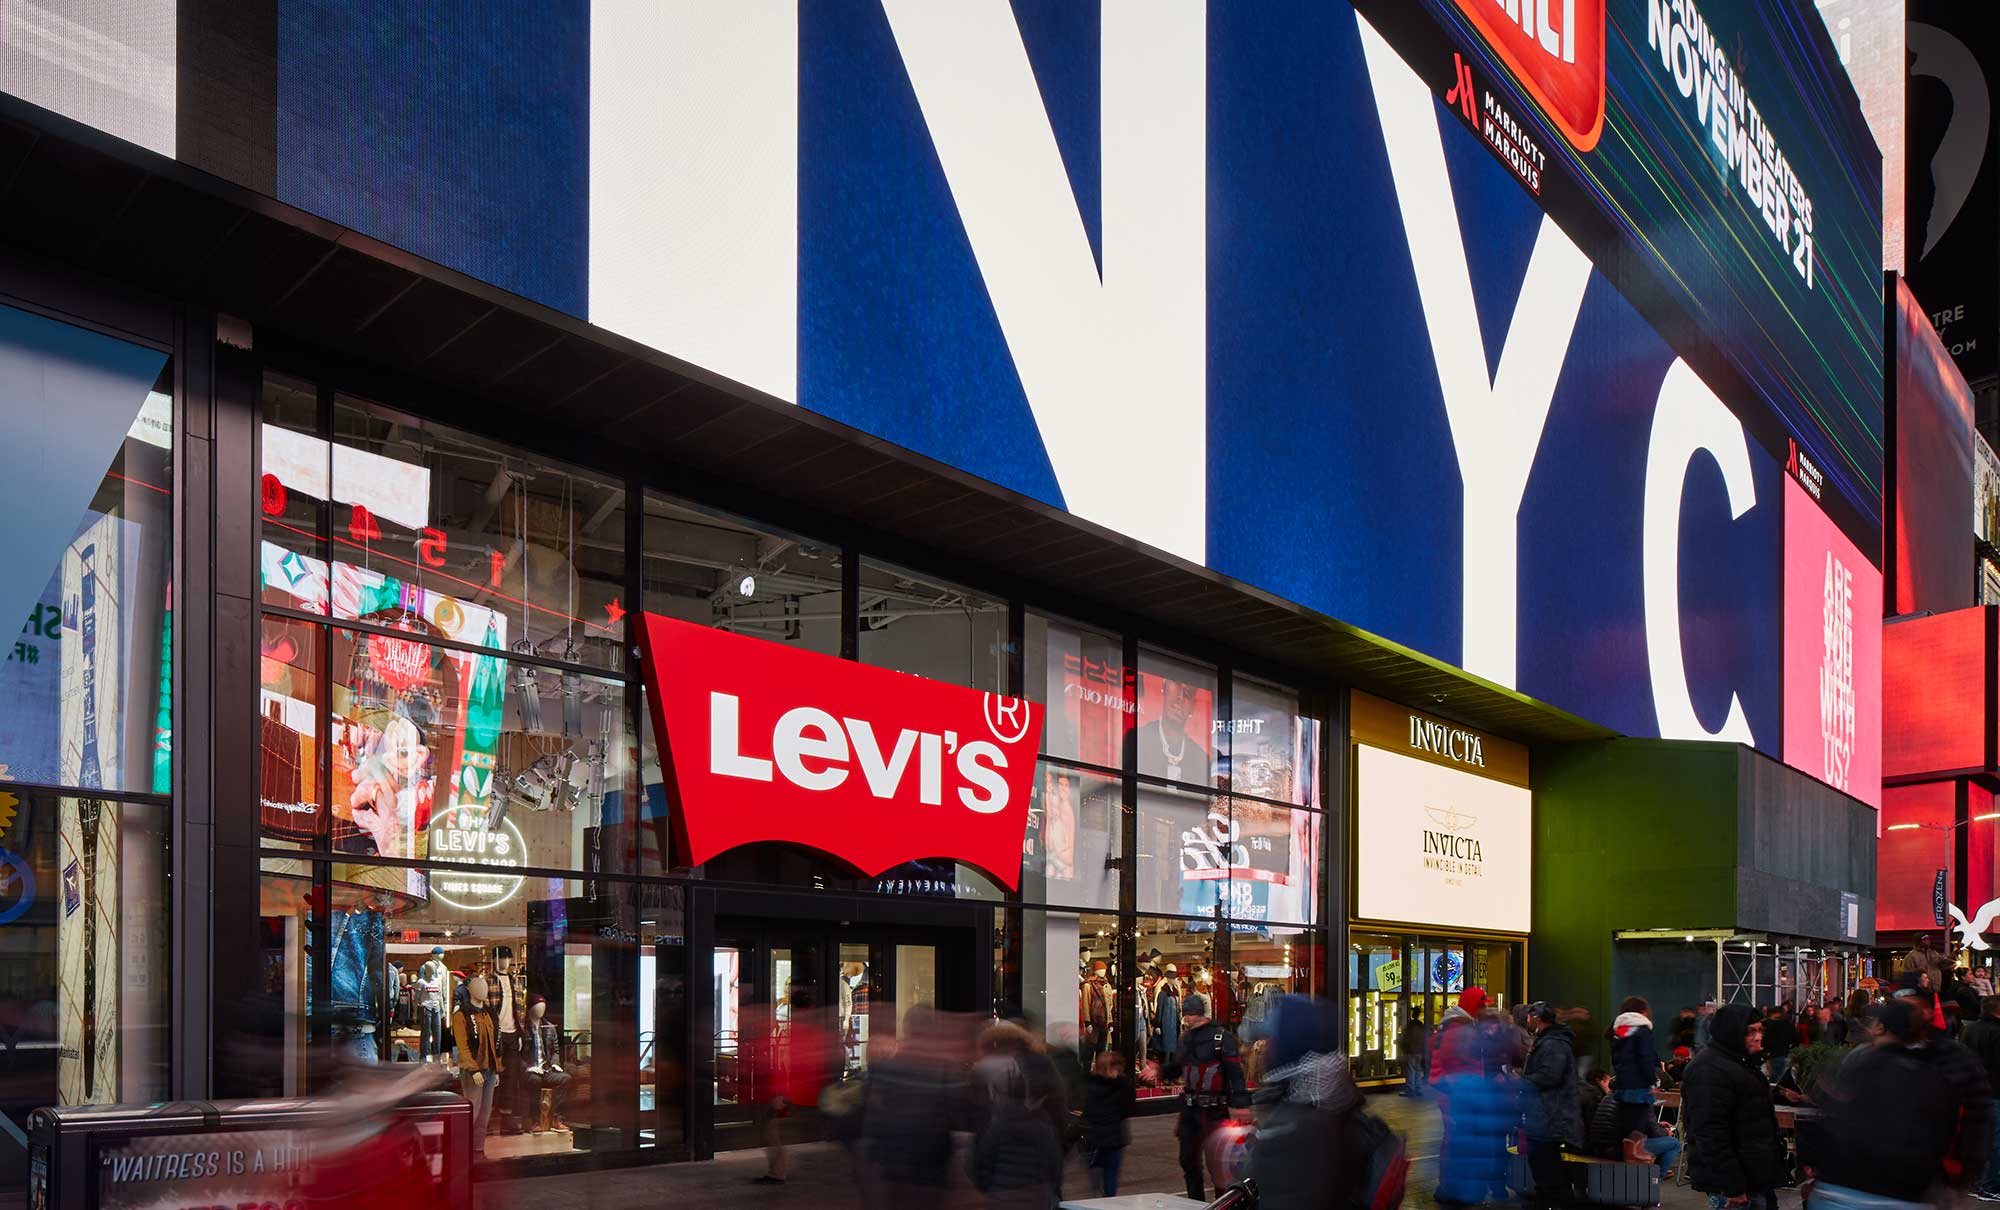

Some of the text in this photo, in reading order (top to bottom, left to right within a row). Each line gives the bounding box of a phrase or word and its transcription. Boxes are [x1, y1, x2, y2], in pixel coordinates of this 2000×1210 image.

[1485, 91, 1546, 171] MARRIOTT
[1485, 121, 1539, 190] MARQUIS
[1648, 0, 1813, 290] NOVEMBER 21
[1729, 67, 1745, 124] IN
[1747, 98, 1813, 233] THEATERS
[1799, 451, 1823, 486] MARRIOTT
[1799, 468, 1821, 499] MARQUIS
[1823, 550, 1853, 618] ARE
[1409, 715, 1486, 768] INVICTA
[1823, 731, 1850, 792] US?
[435, 828, 511, 855] LEVI'S
[1423, 830, 1482, 862] INVICTA
[443, 881, 504, 894] TIMES SQUARE
[226, 1150, 245, 1175] IS
[253, 1150, 265, 1173] A
